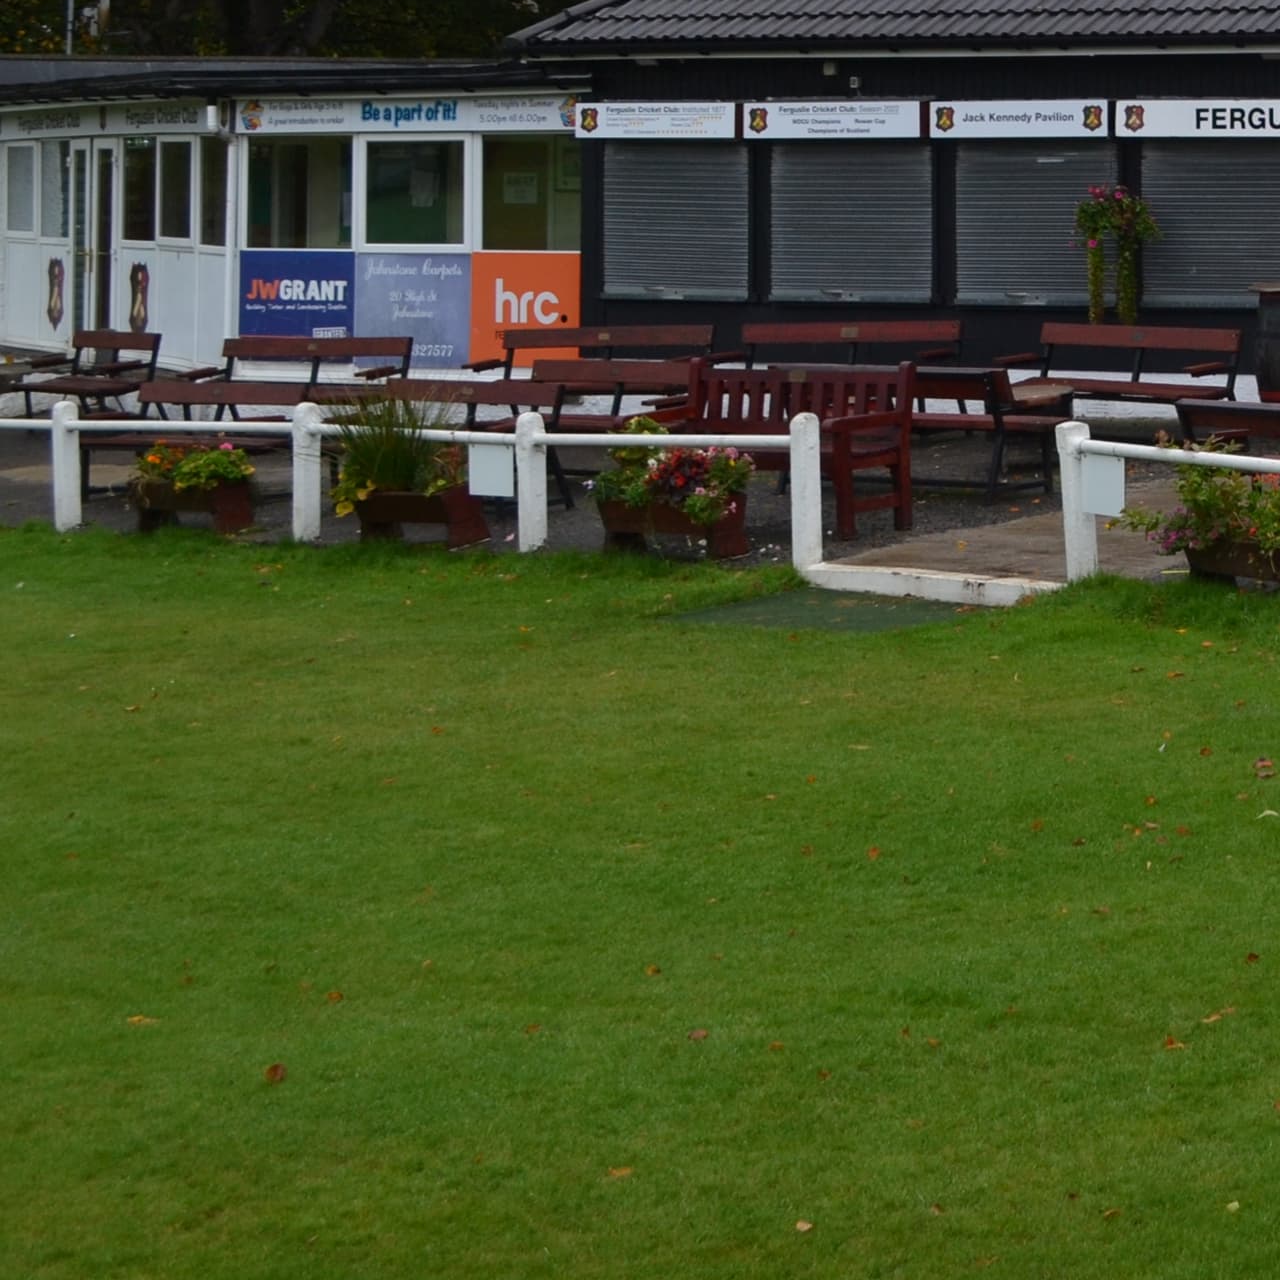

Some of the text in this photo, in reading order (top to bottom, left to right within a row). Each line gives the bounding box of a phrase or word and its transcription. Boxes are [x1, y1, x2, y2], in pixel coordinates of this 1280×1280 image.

[361, 100, 381, 120] Be
[383, 108, 392, 120] a
[394, 102, 422, 127] part
[425, 99, 442, 120] of
[962, 111, 1075, 124] Jack Kennedy Pavilion
[364, 257, 463, 280] Johnstone Carpets
